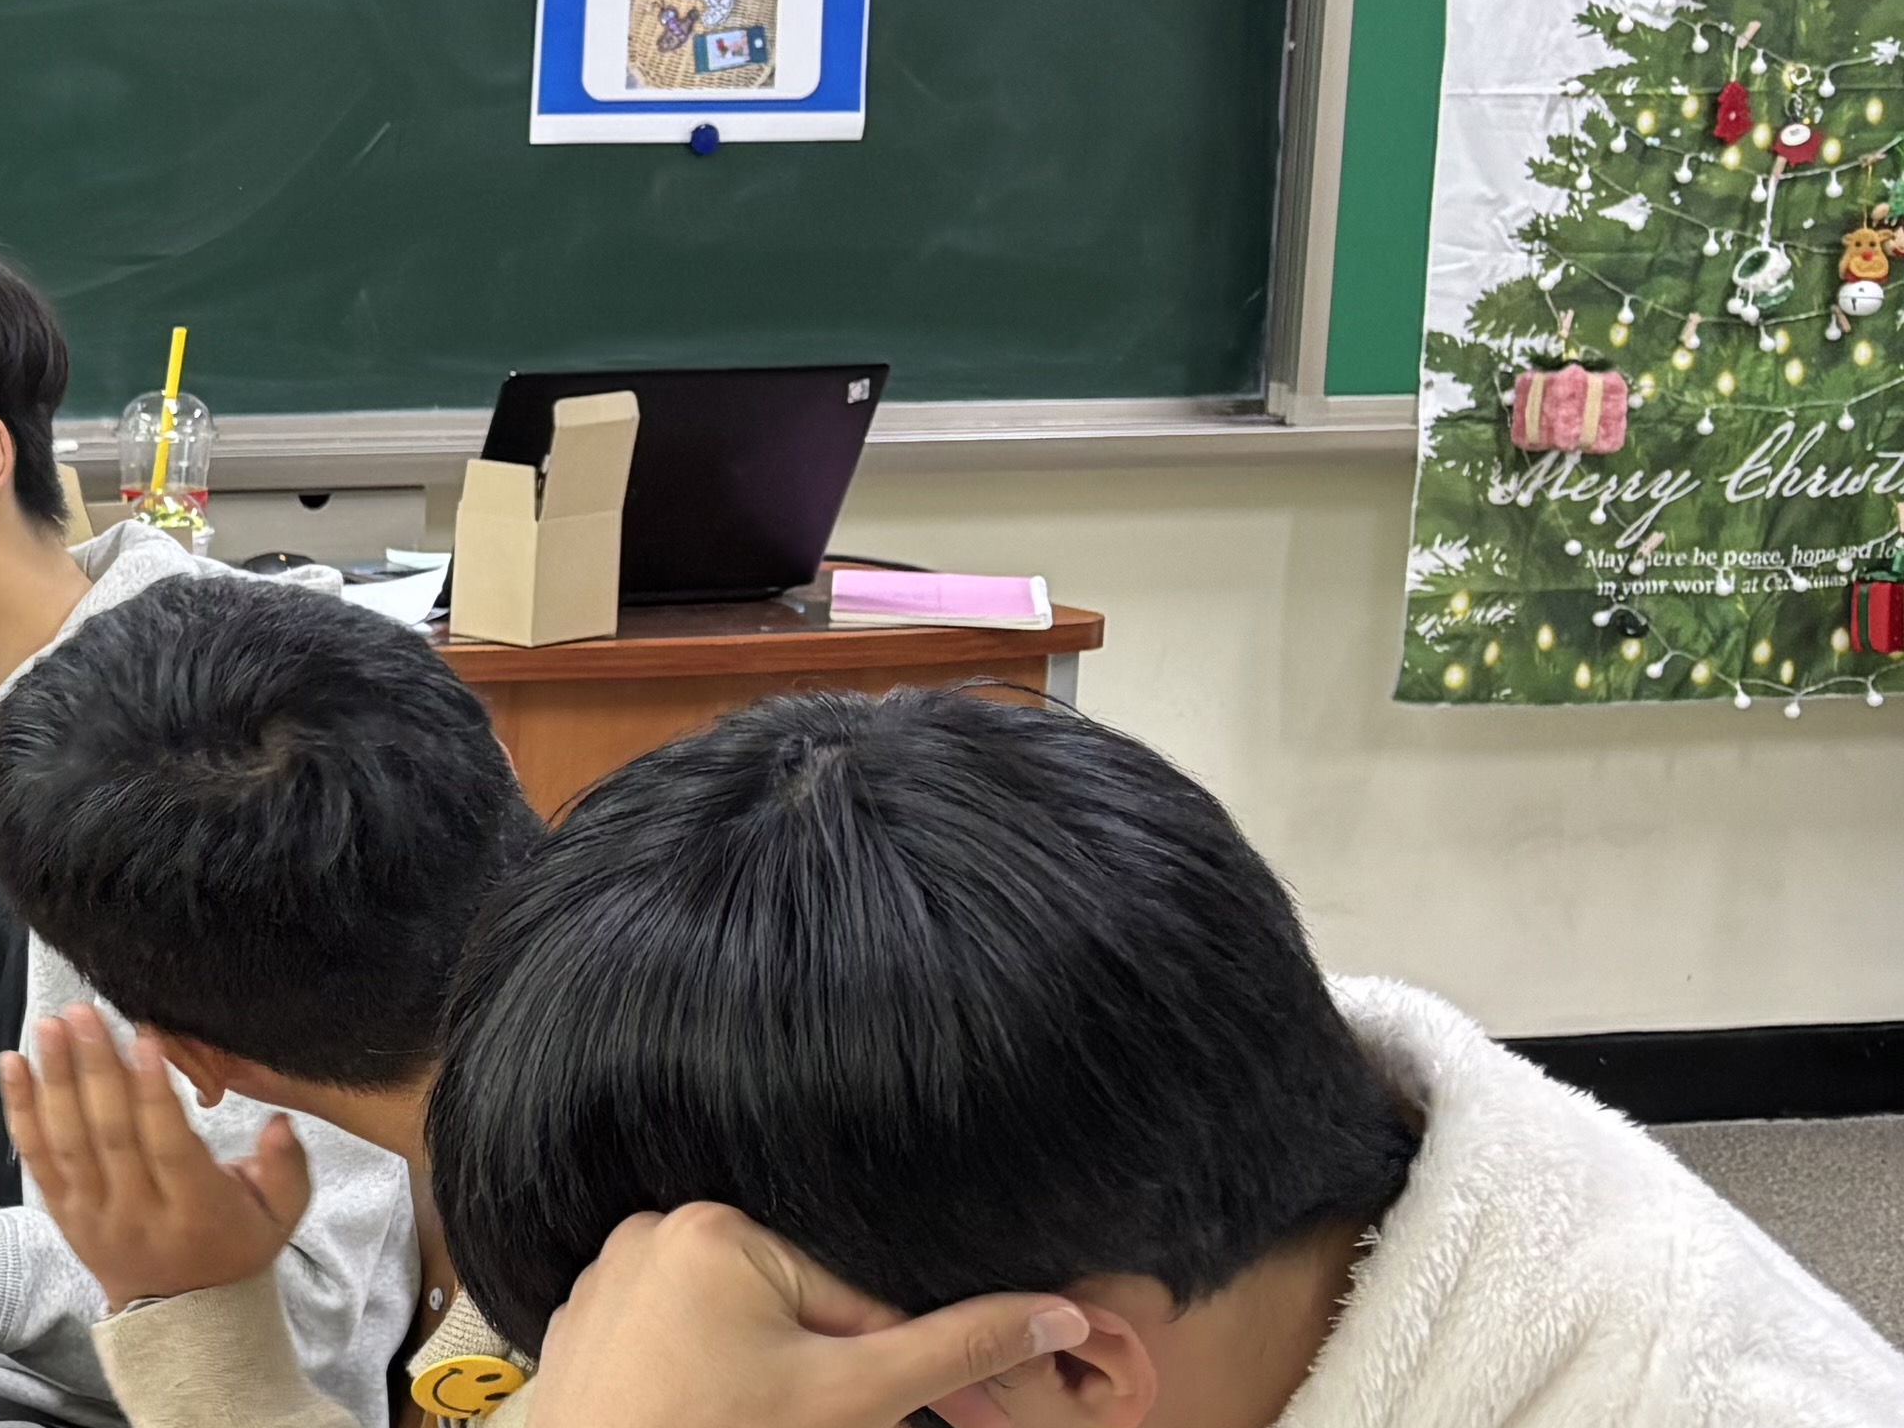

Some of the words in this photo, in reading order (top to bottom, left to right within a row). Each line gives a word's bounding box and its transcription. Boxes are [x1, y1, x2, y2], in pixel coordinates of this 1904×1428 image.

[1489, 450, 1702, 549] Merry
[1585, 549, 1630, 573] May
[1693, 547, 1717, 566] be
[1723, 547, 1786, 569] peace,
[1596, 579, 1617, 597] in
[1622, 580, 1669, 601] your
[1741, 577, 1759, 594] at
